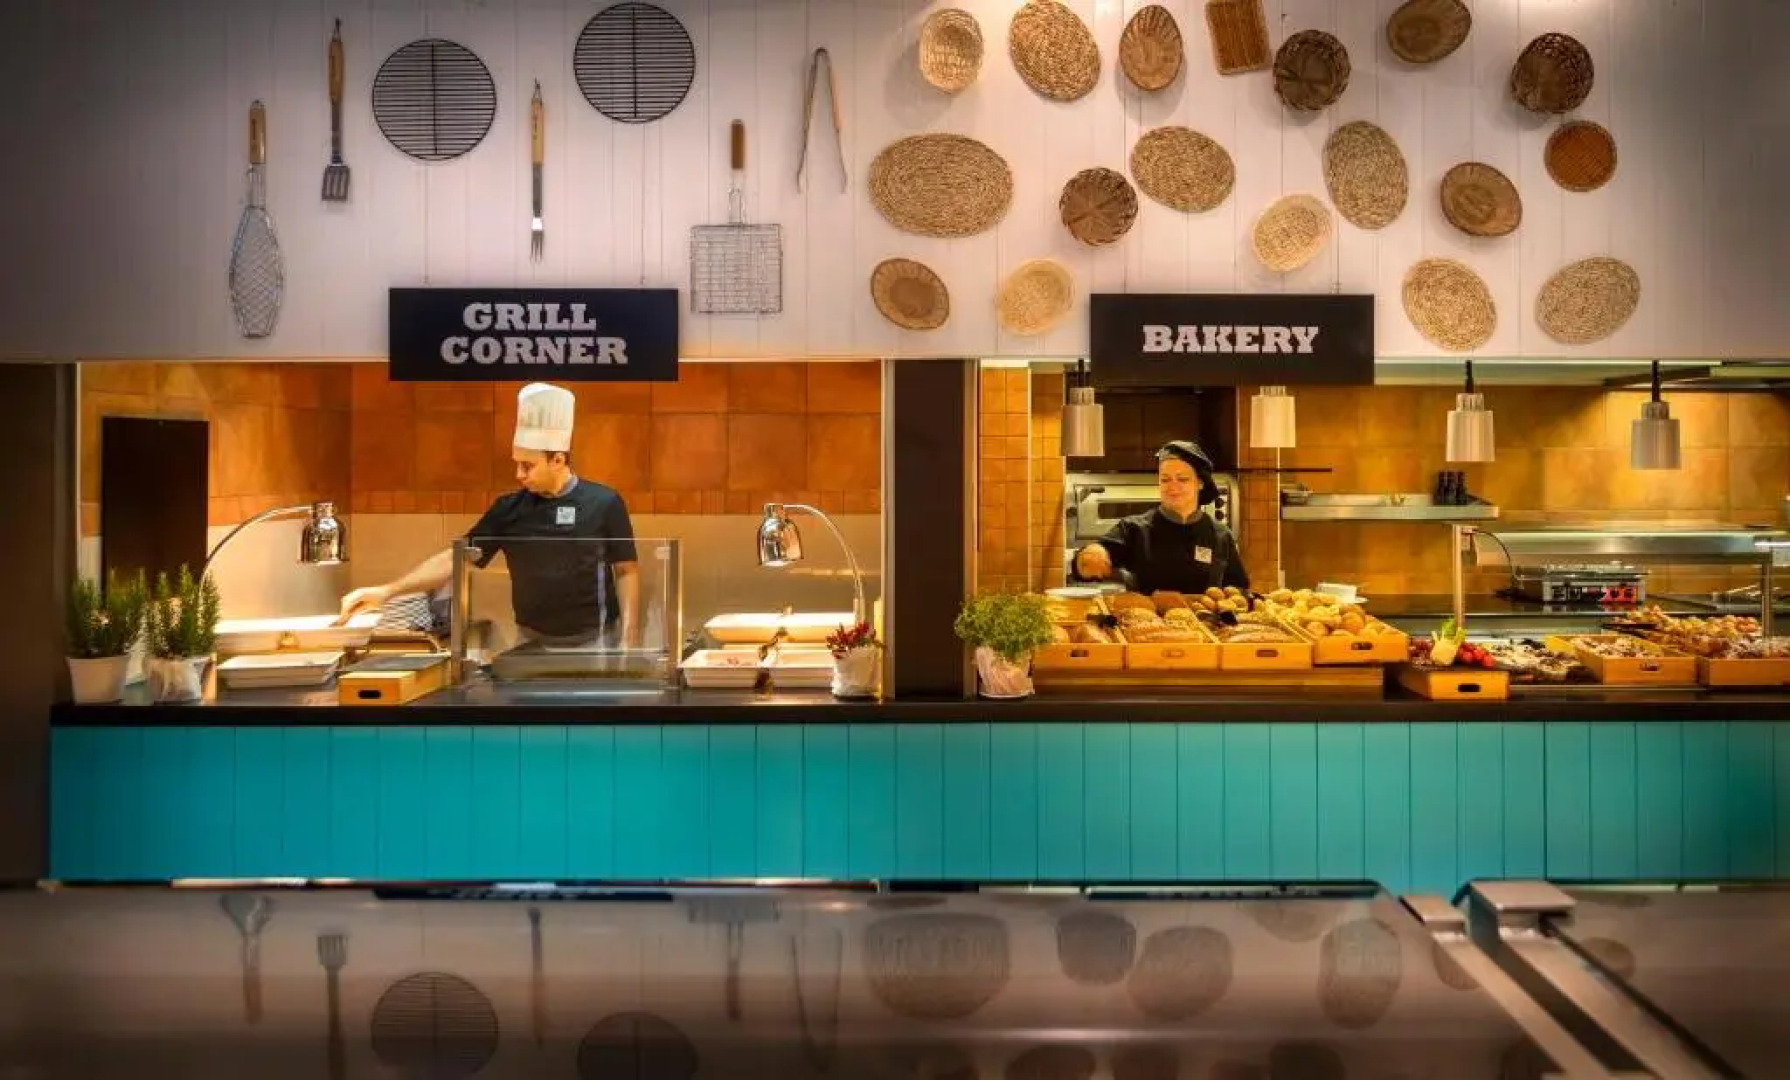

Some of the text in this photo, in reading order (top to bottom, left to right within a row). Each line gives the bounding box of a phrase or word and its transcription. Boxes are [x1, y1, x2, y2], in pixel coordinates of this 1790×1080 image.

[463, 302, 596, 331] GRILL
[440, 336, 628, 364] CORNER
[1142, 324, 1319, 354] BAKERY
